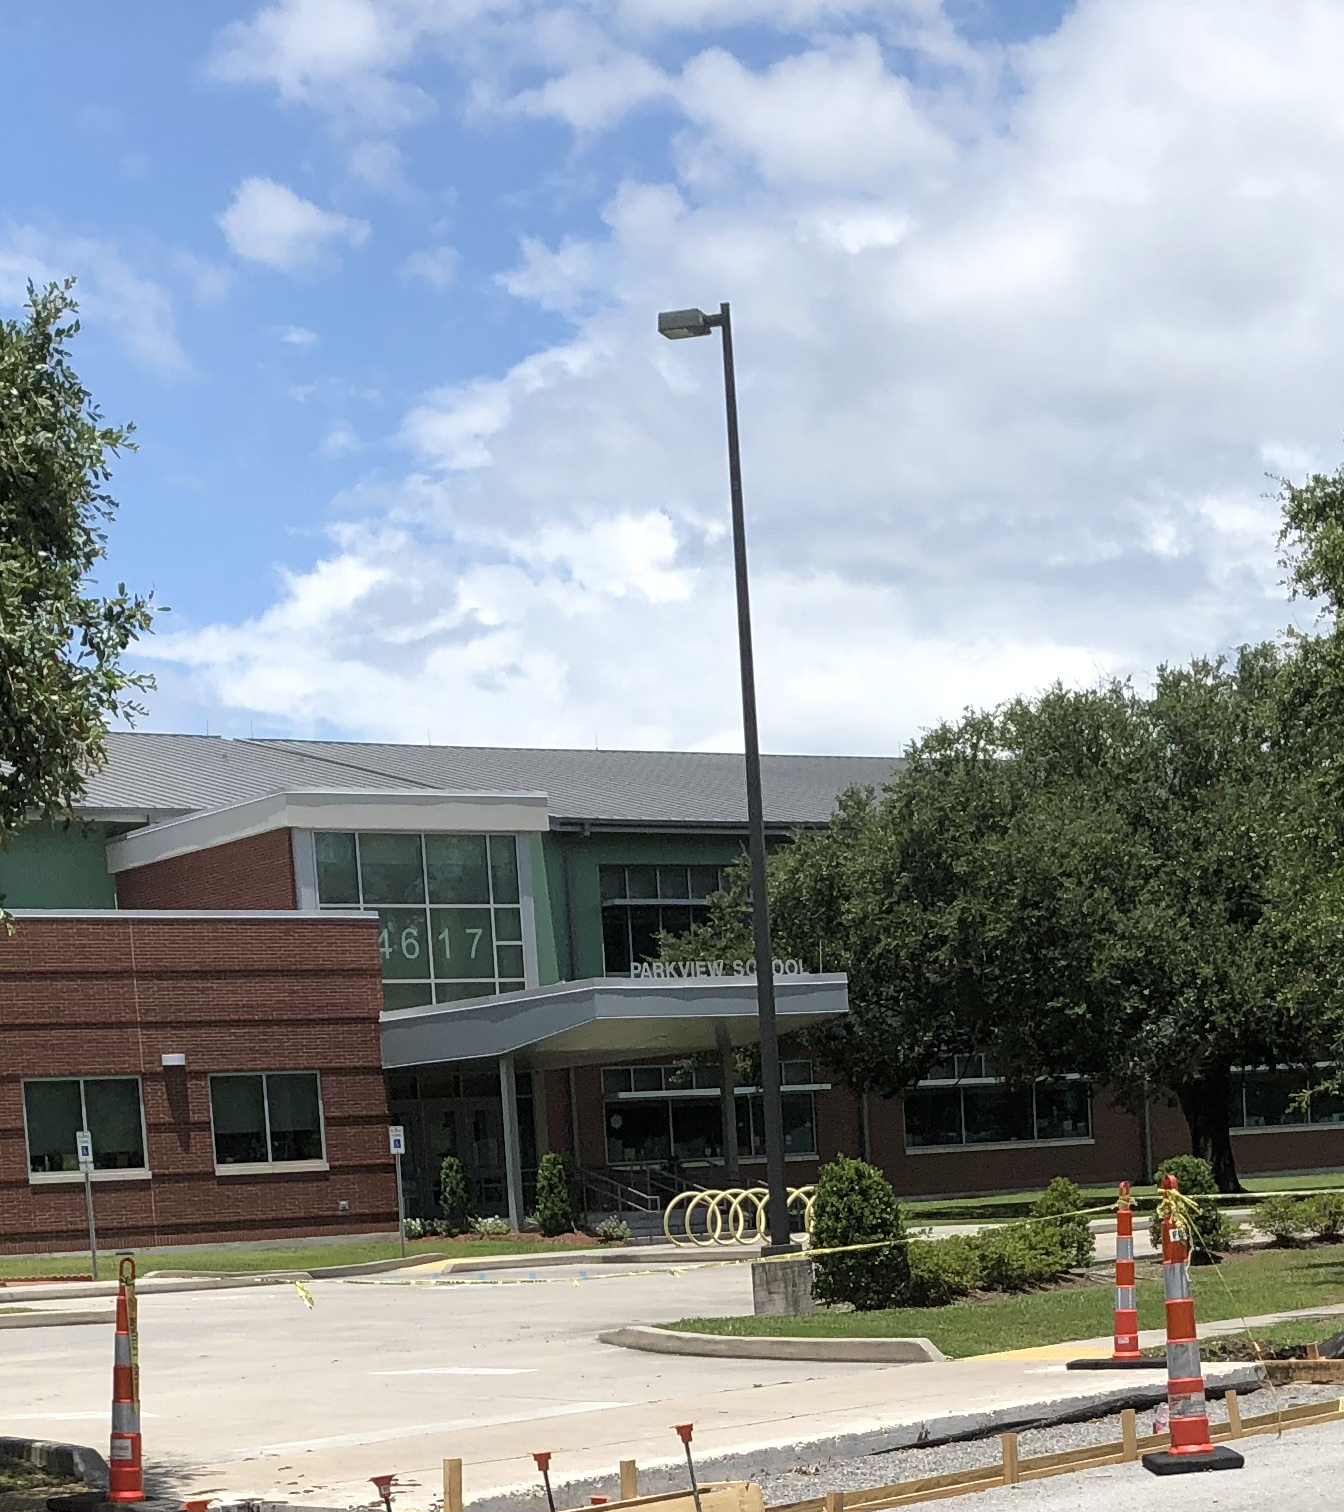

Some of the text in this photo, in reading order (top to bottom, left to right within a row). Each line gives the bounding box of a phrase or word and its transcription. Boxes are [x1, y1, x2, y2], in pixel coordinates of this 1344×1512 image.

[378, 927, 483, 959] 4617
[630, 958, 809, 979] PARKVIEW SCOOL
